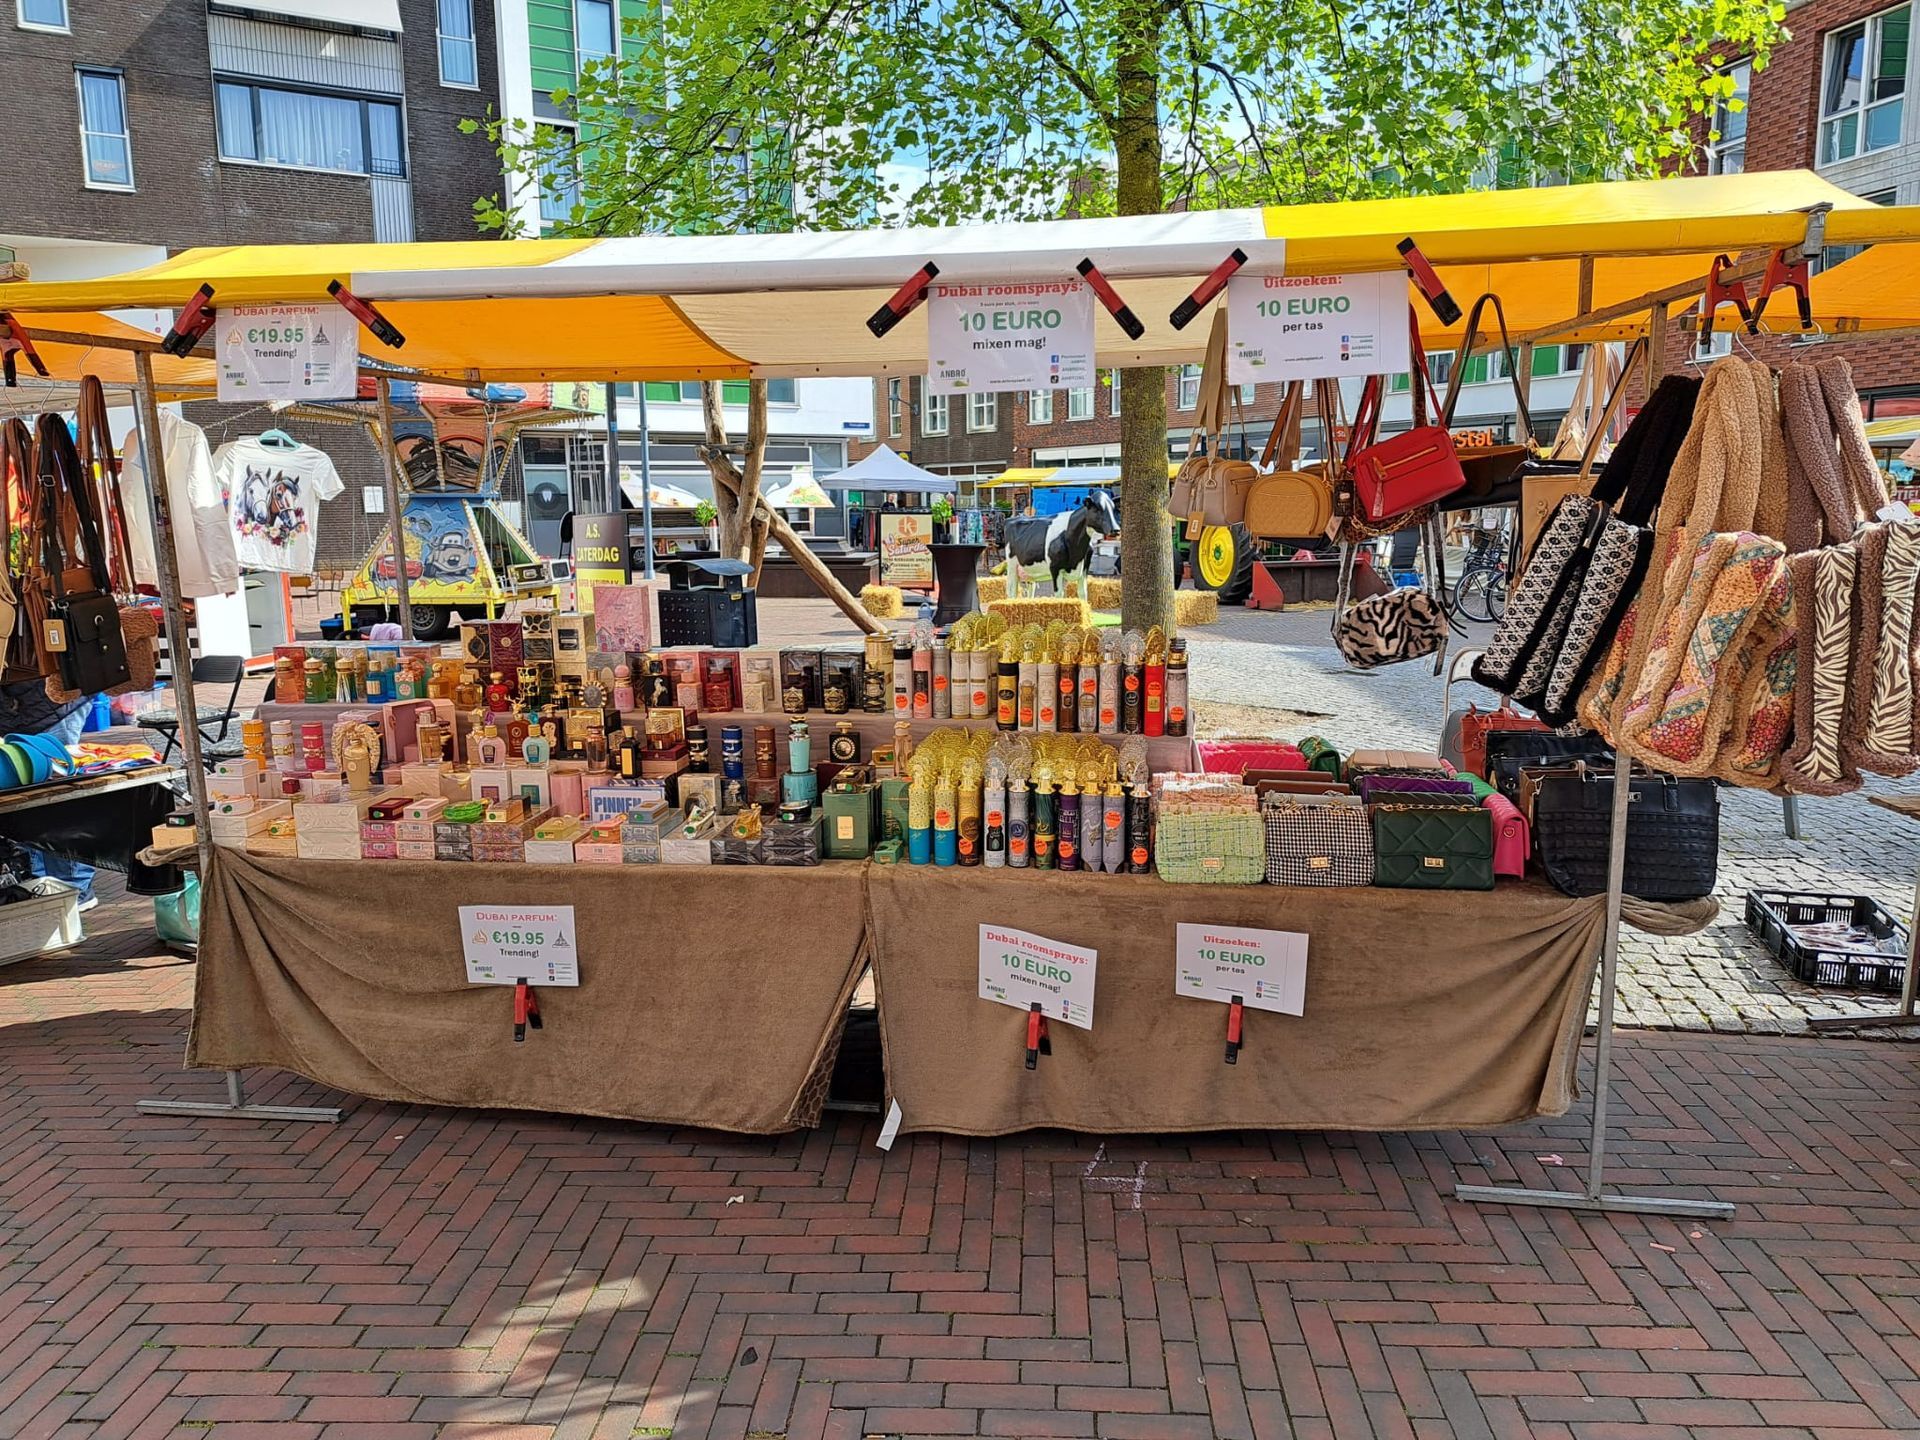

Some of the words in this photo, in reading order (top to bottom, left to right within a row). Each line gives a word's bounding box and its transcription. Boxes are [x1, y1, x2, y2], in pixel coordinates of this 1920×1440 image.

[1264, 275, 1342, 288] Uitzoeken:
[938, 283, 982, 298] Dubai
[987, 281, 1083, 297] roomsprays:
[233, 304, 268, 317] DUBAI
[271, 305, 320, 316] PARFUM:
[1256, 300, 1281, 317] 10
[1287, 296, 1351, 316] EURO
[958, 312, 986, 332] 10
[992, 309, 1062, 331] EURO
[1282, 322, 1301, 334] per
[1305, 321, 1324, 331] tas
[247, 328, 304, 344] €19.95
[973, 339, 1011, 350] mixen
[1014, 336, 1046, 350] mag!
[254, 348, 297, 359] Trending!
[1452, 427, 1493, 448] stal
[585, 523, 600, 539] A.S.
[897, 537, 920, 548] Super
[577, 546, 620, 563] ZATERDAG
[476, 912, 508, 921] DUBAI
[511, 914, 557, 922] PARFUM:
[492, 931, 544, 945] €19.95
[1203, 935, 1261, 948] Uitzoeken:
[499, 948, 539, 958] Trending!
[986, 932, 1019, 945] Dubai
[1022, 940, 1088, 965] roomsprays:
[1198, 949, 1215, 960] 10
[1220, 951, 1266, 967] EURO
[1001, 954, 1020, 969] 10
[1025, 959, 1072, 984] EURO
[1216, 965, 1230, 973] per
[1231, 966, 1245, 974] tas
[1011, 974, 1038, 986] mixen
[1039, 982, 1061, 994] mag!
